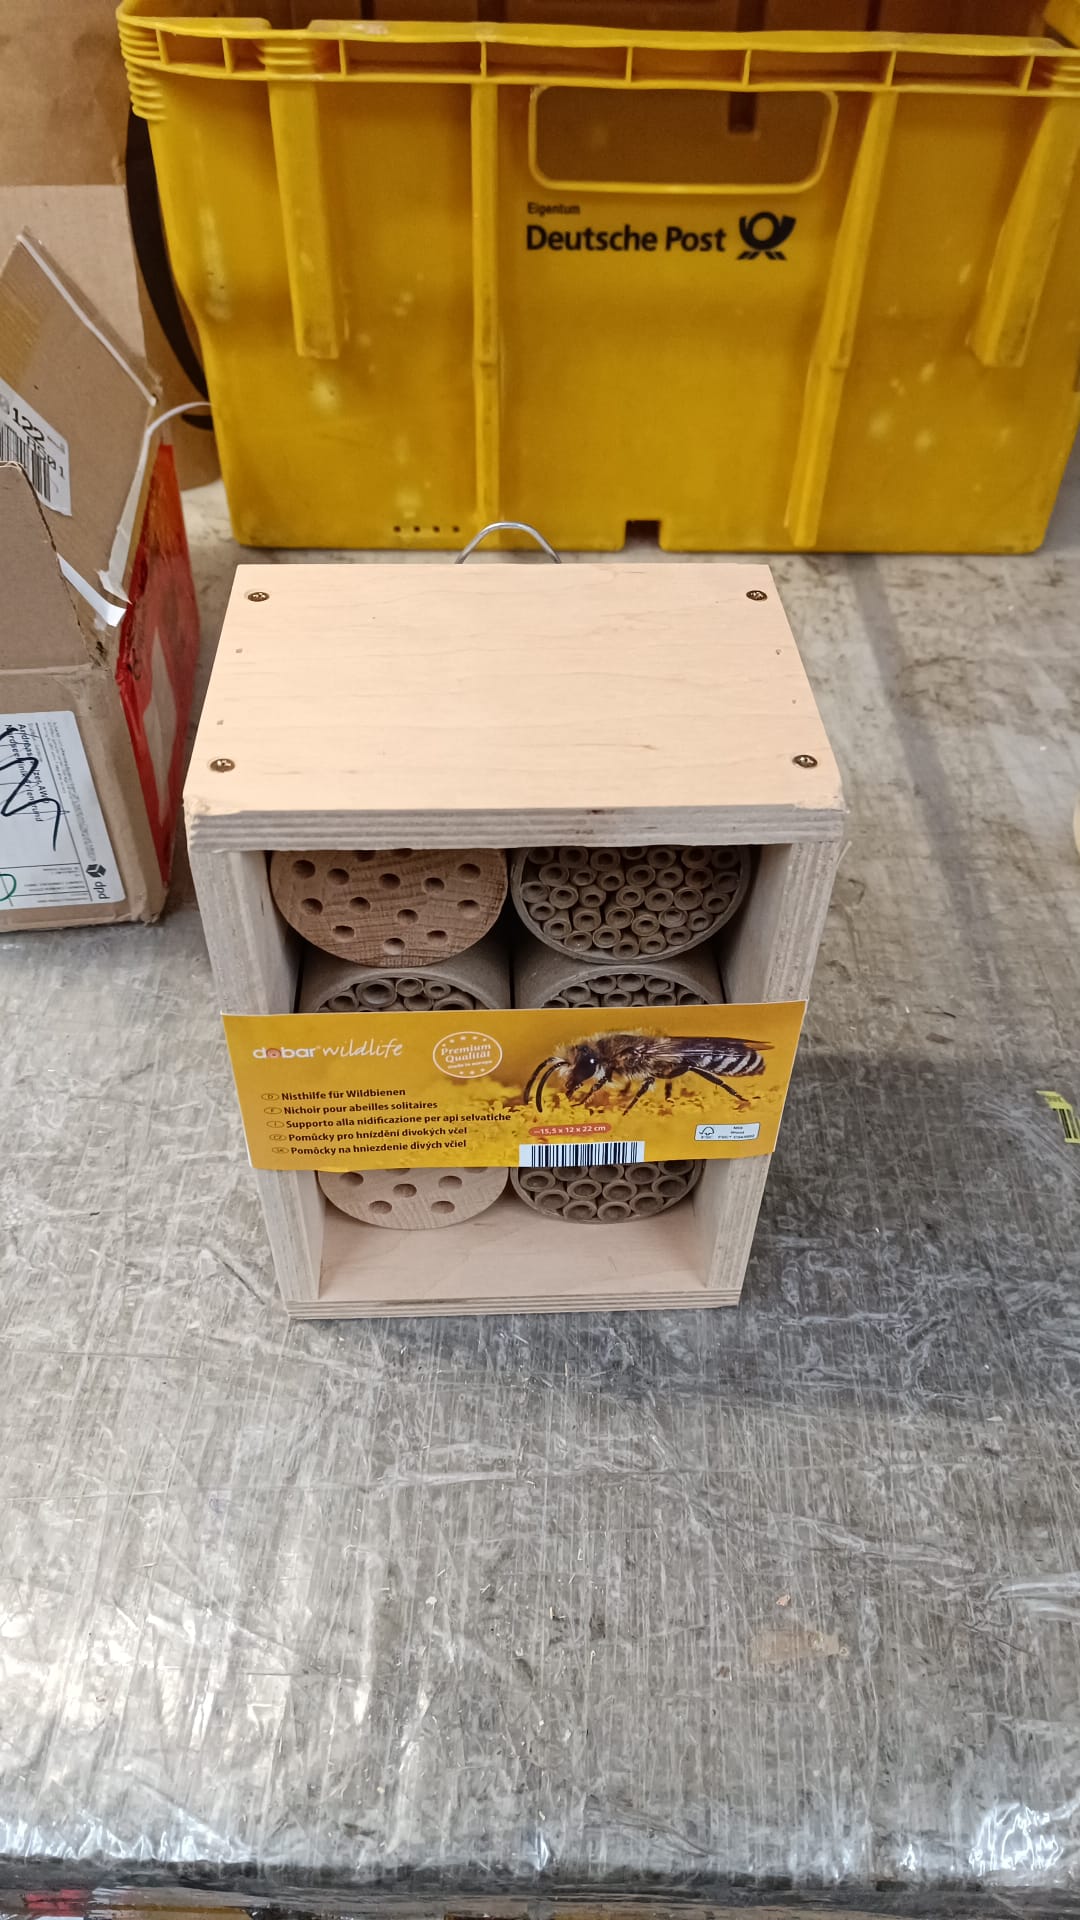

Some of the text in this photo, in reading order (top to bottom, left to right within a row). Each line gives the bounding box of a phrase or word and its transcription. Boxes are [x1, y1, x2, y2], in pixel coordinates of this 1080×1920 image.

[527, 202, 580, 217] Eigentum
[527, 224, 726, 251] Deutsche Post
[93, 881, 111, 899] dpd
[252, 1037, 404, 1060] dobar wildlife
[441, 1044, 491, 1056] Premium
[445, 1050, 490, 1063] Qualität
[281, 1091, 326, 1101] Nisthilfe
[328, 1090, 344, 1099] für
[346, 1089, 406, 1098] Wildbienen
[284, 1106, 320, 1115] Nichoir
[323, 1106, 347, 1115] pour
[349, 1103, 389, 1112] abeilles
[391, 1101, 438, 1110] solitaires
[286, 1120, 334, 1129] Supporto
[336, 1118, 354, 1127] alla
[357, 1115, 422, 1125] nidificazione
[424, 1115, 441, 1123] per
[443, 1114, 459, 1122] api
[461, 1113, 511, 1122] selvatiche
[288, 1132, 335, 1142] Pomůcky
[337, 1133, 354, 1141] pro
[356, 1129, 399, 1139] hnízdění
[402, 1127, 446, 1137] divokých
[448, 1127, 467, 1135] včel
[291, 1146, 336, 1156] Pomôcky
[353, 1144, 408, 1153] hniezdenie
[410, 1141, 442, 1150] divých
[444, 1140, 467, 1148] včiel
